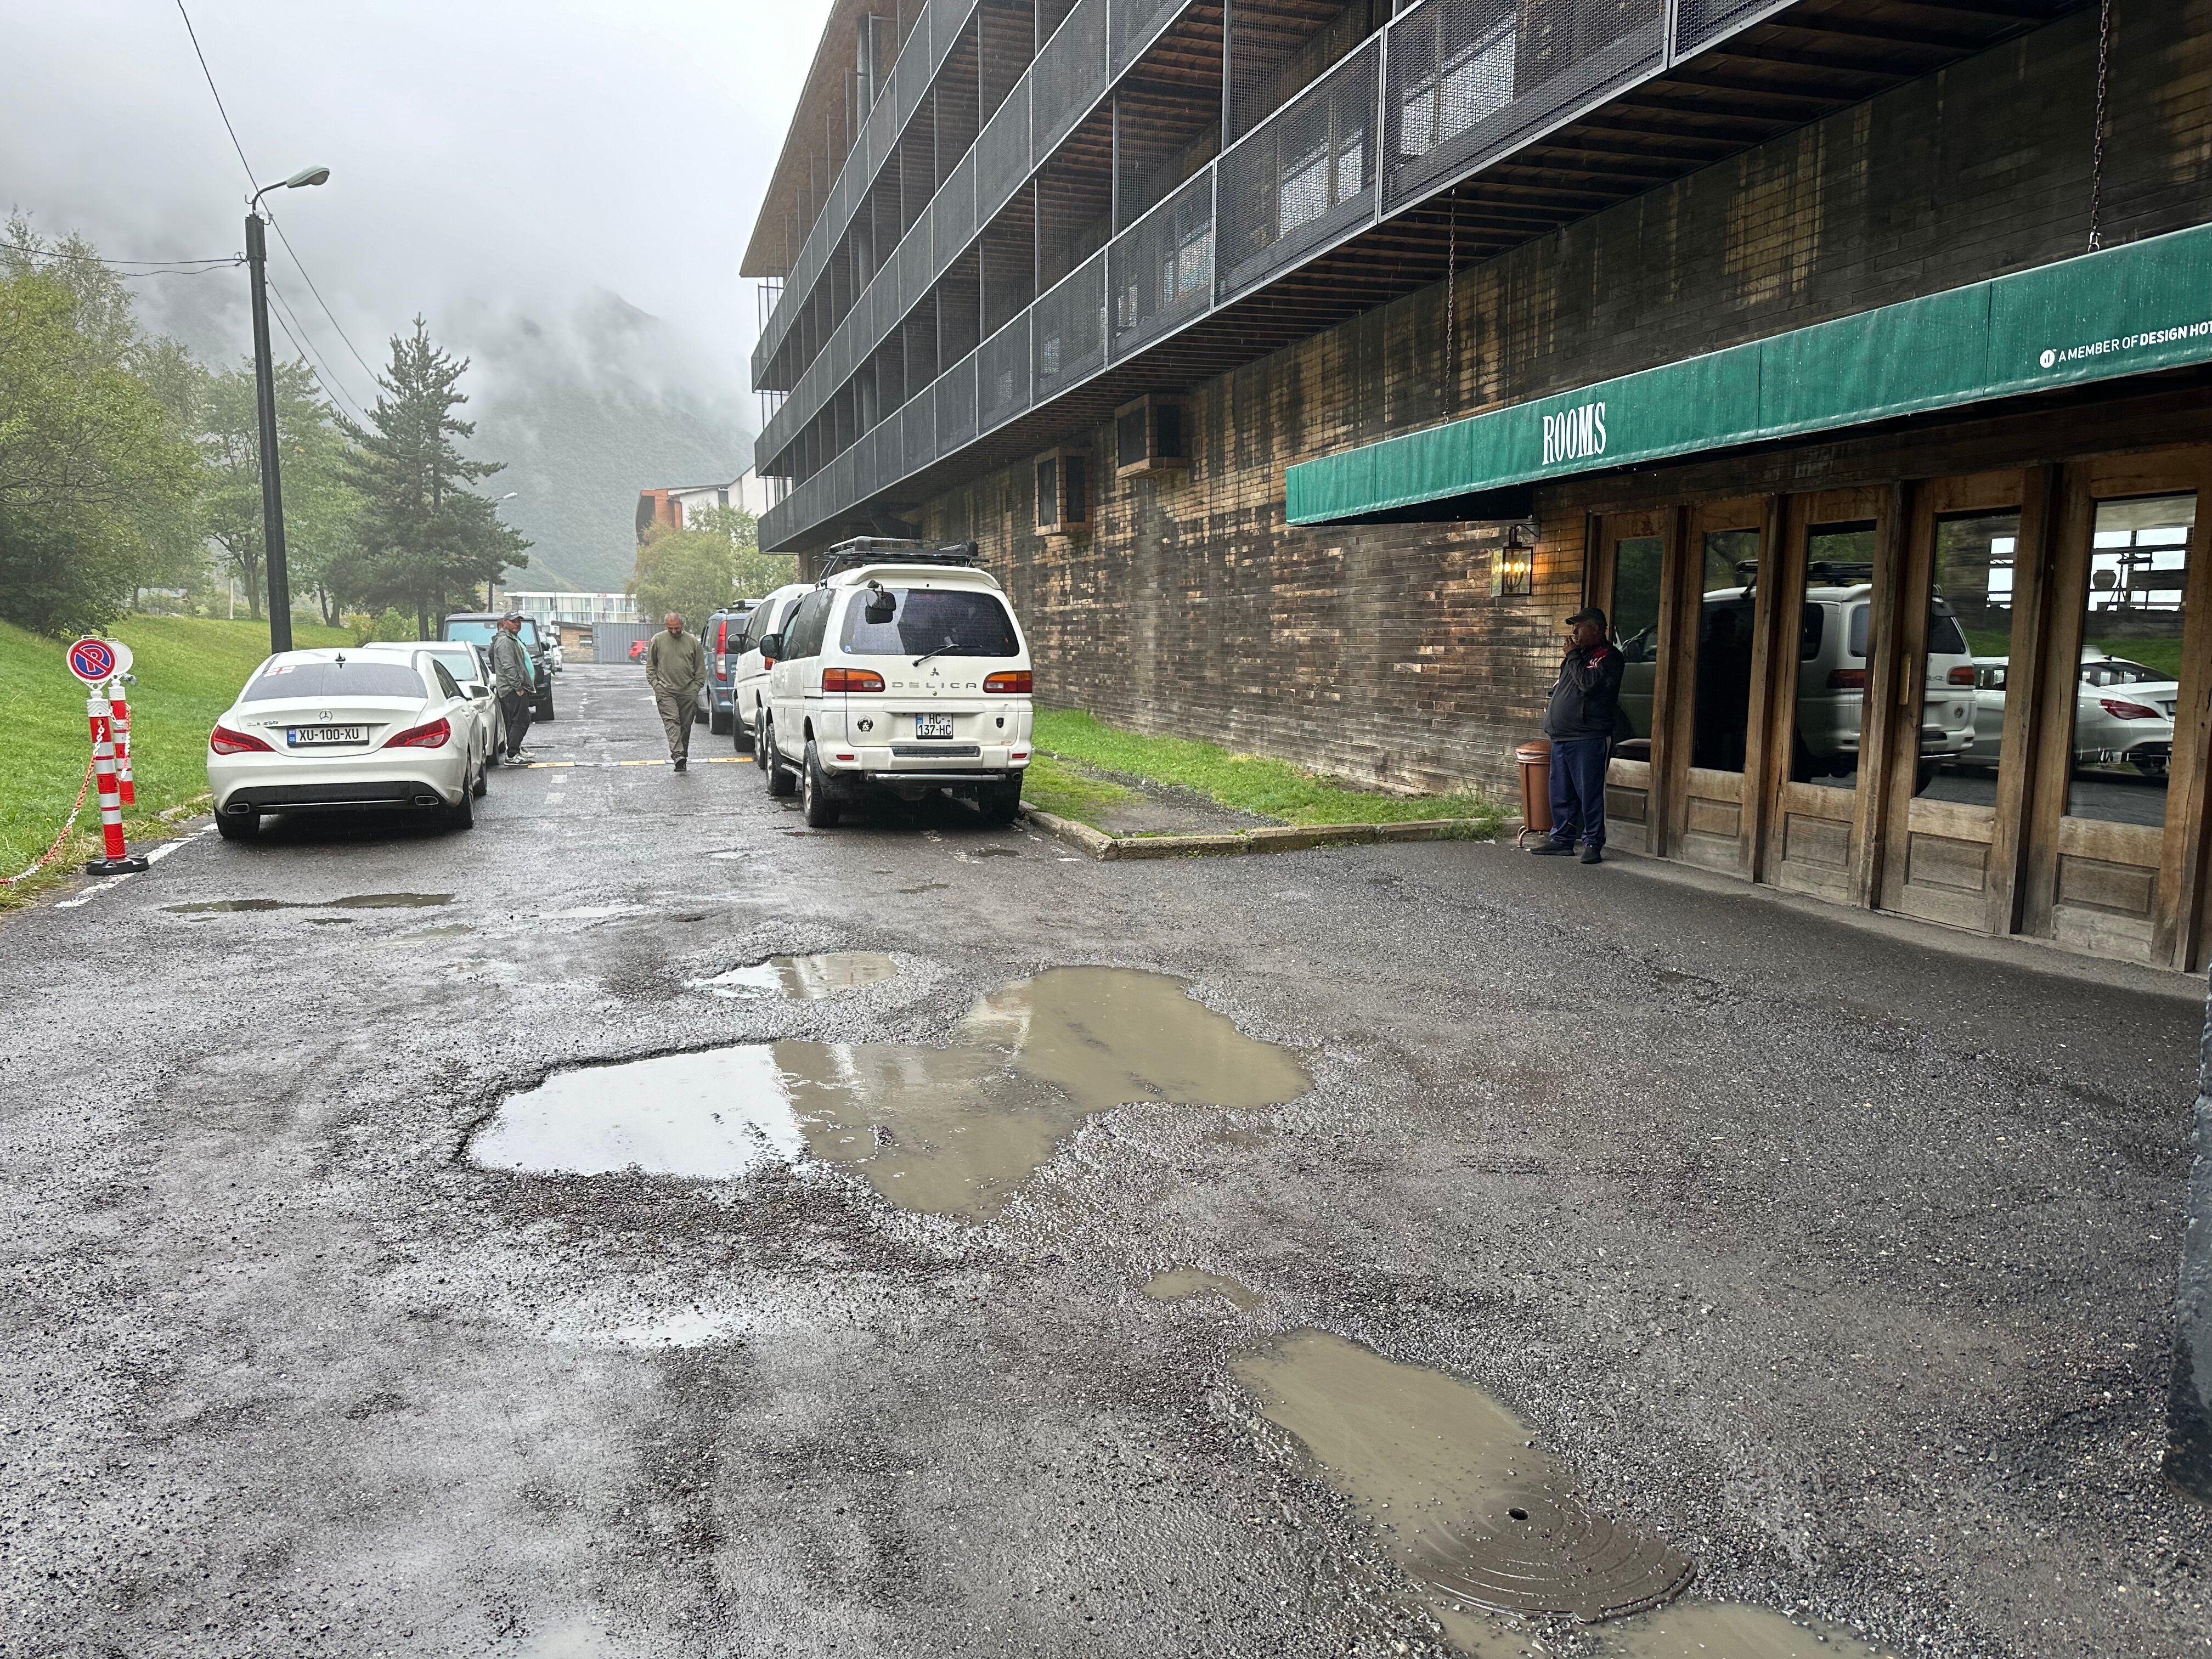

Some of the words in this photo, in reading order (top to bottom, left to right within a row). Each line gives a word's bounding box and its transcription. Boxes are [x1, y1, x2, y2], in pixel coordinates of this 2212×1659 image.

[2058, 350, 2067, 363] A
[2068, 339, 2119, 360] MEMBER
[2122, 335, 2138, 349] OF
[2140, 326, 2187, 346] DESIGN
[2190, 320, 2212, 337] HOT
[1542, 402, 1606, 465] ROOMS
[300, 728, 359, 741] XU-100-XU
[918, 725, 951, 735] 137-HC
